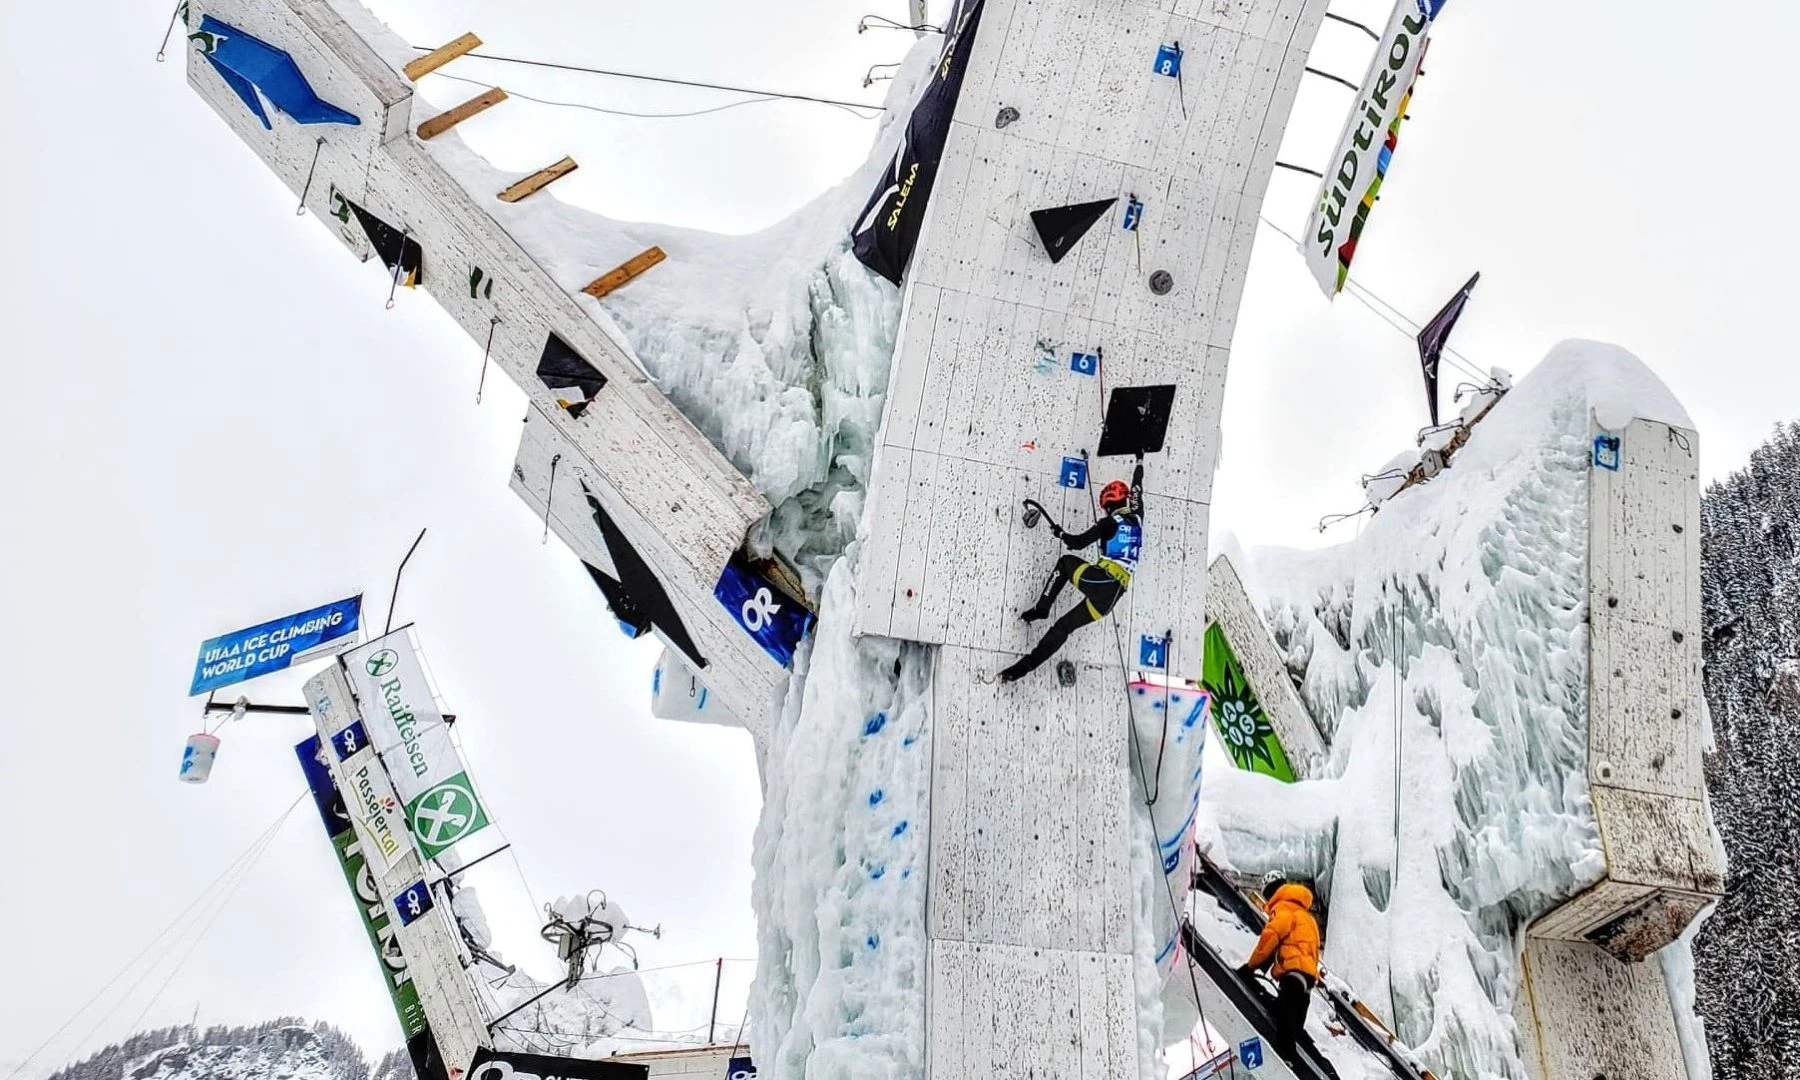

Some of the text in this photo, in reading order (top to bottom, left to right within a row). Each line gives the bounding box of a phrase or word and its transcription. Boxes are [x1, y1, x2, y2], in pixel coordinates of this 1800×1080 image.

[1161, 60, 1172, 75] 8
[886, 162, 920, 232] SALEWA
[1079, 353, 1089, 369] 6
[1068, 471, 1079, 487] 5
[742, 587, 782, 632] OR
[205, 612, 343, 664] UIAA ICE CLIMBING
[202, 644, 290, 680] WORLD CUP
[1147, 649, 1158, 667] 4
[344, 729, 357, 752] OR
[380, 676, 430, 778] Raiffeisen
[355, 765, 400, 858] Passeiertal
[407, 889, 421, 916] OR
[404, 1004, 422, 1035] BIER
[1247, 1051, 1257, 1069] 2
